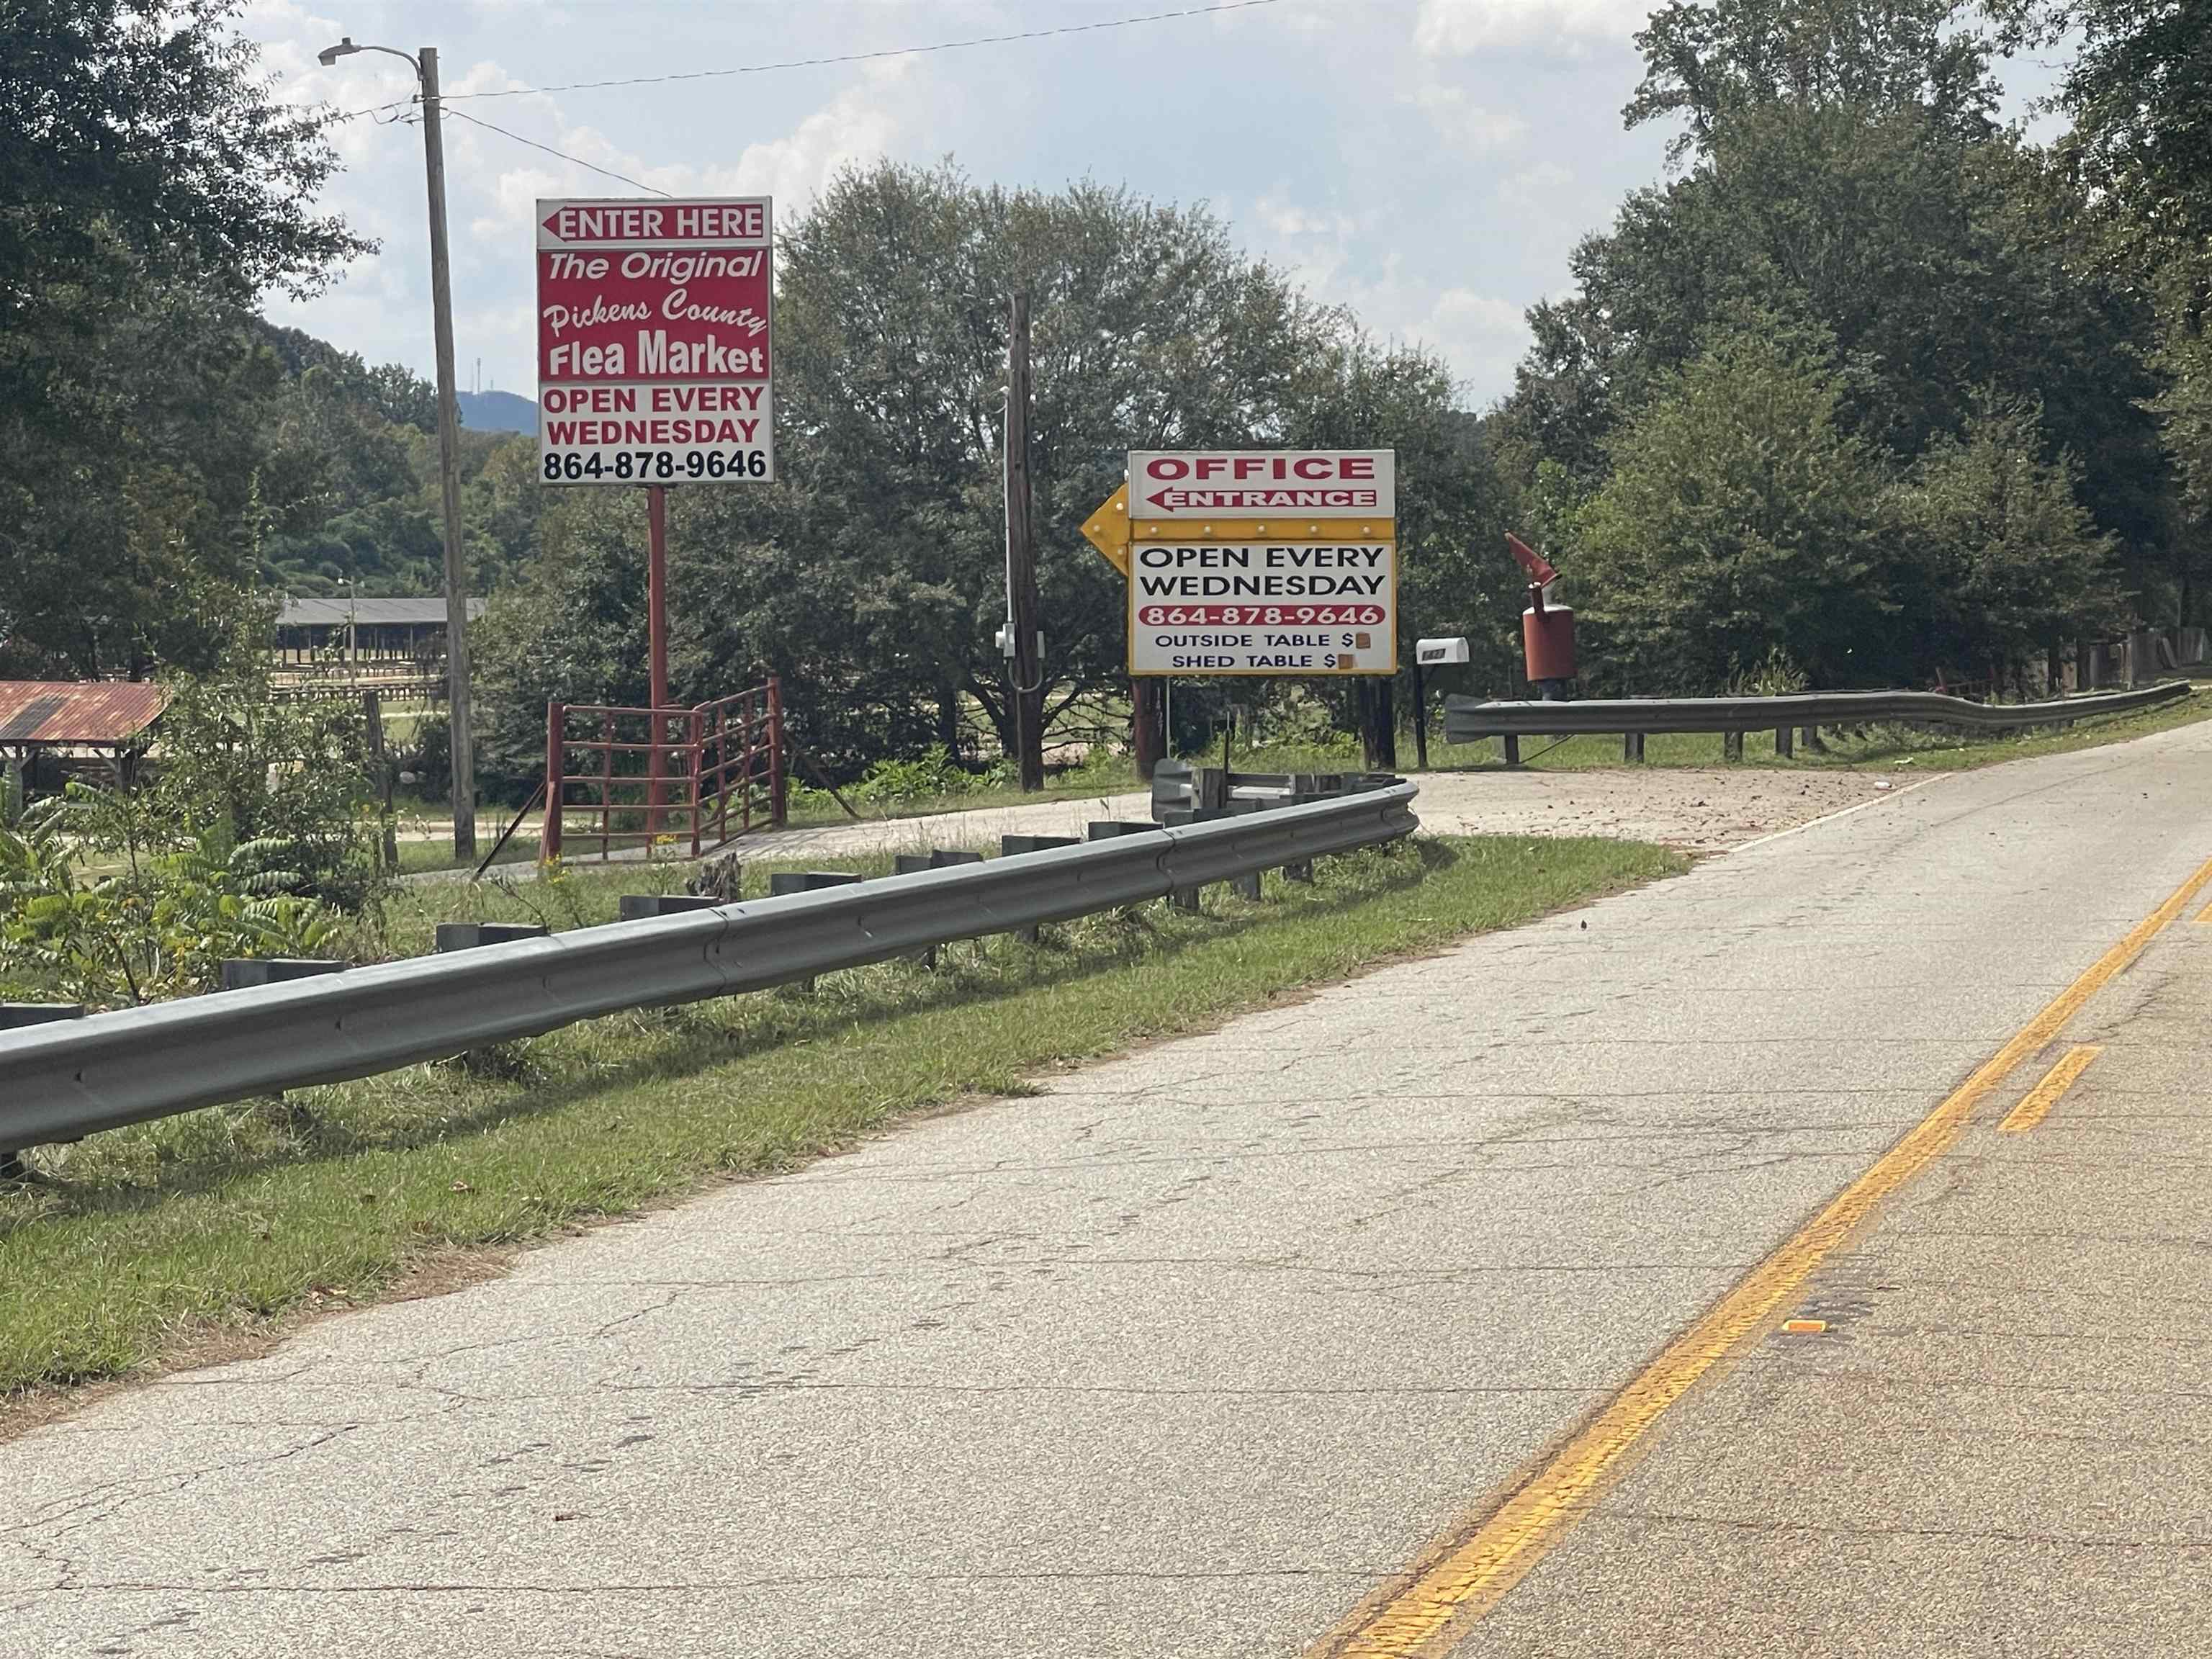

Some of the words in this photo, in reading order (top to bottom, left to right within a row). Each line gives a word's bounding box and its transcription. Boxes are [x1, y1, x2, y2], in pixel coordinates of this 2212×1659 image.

[559, 209, 664, 238] ENTER
[677, 208, 762, 235] HERE
[549, 253, 609, 279] The
[621, 251, 763, 284] Original
[543, 295, 652, 338] Pickens
[662, 288, 767, 338] County
[550, 341, 624, 375] Flea
[638, 330, 763, 374] Market
[544, 388, 636, 413] OPEN
[652, 387, 765, 412] EVERY
[547, 418, 760, 445] WEDNESDAY
[544, 450, 766, 480] 864-878-9646
[1146, 458, 1375, 480] OFFICE
[1164, 490, 1375, 506] ENTRANCE
[1140, 547, 1249, 568] OPEN
[1267, 547, 1385, 567] EVERY
[1140, 575, 1386, 596] WEDNESDAY
[1146, 607, 1379, 624] 864-878-9646
[1155, 634, 1252, 647] OUTSIDE
[1264, 634, 1330, 646] TABLE
[1172, 655, 1235, 668] SHED
[1246, 655, 1312, 667] TABLE
